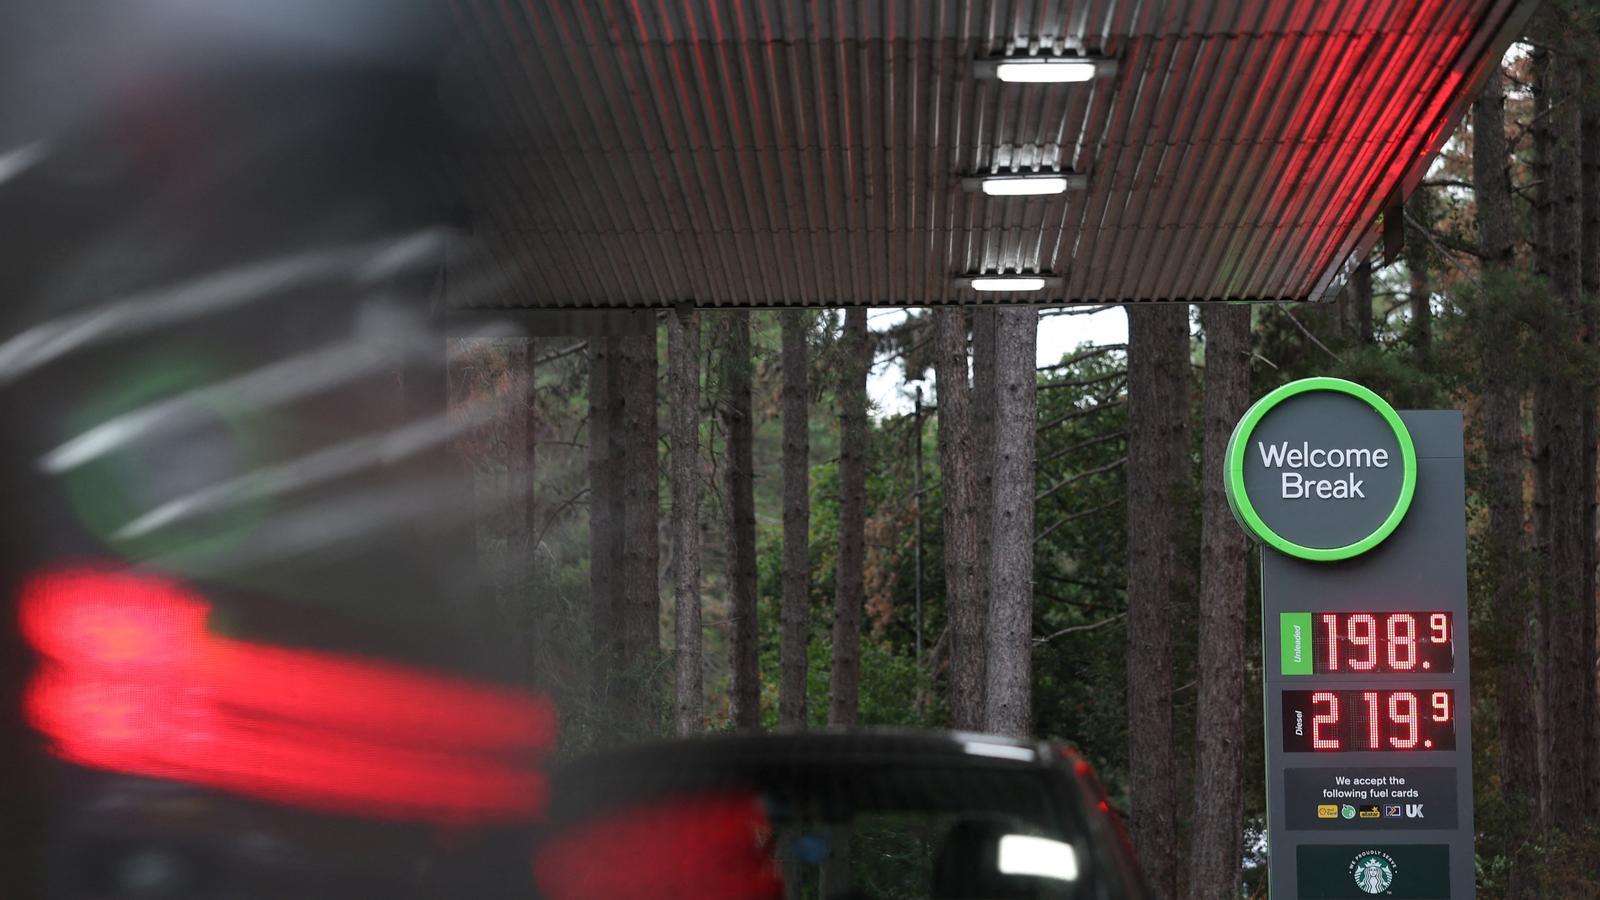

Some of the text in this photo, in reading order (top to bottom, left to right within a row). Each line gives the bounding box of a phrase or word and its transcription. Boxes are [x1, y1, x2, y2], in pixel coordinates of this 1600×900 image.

[1258, 441, 1389, 468] Welcome
[1281, 472, 1365, 499] Break
[1293, 624, 1302, 663] Unleaded
[1295, 710, 1303, 736] Diesel
[1335, 776, 1405, 788] We accept the
[1323, 788, 1419, 800] following fuel cards
[1406, 804, 1424, 818] UK
[1355, 849, 1381, 861] PROUDLY
[1382, 853, 1397, 868] SERVE
